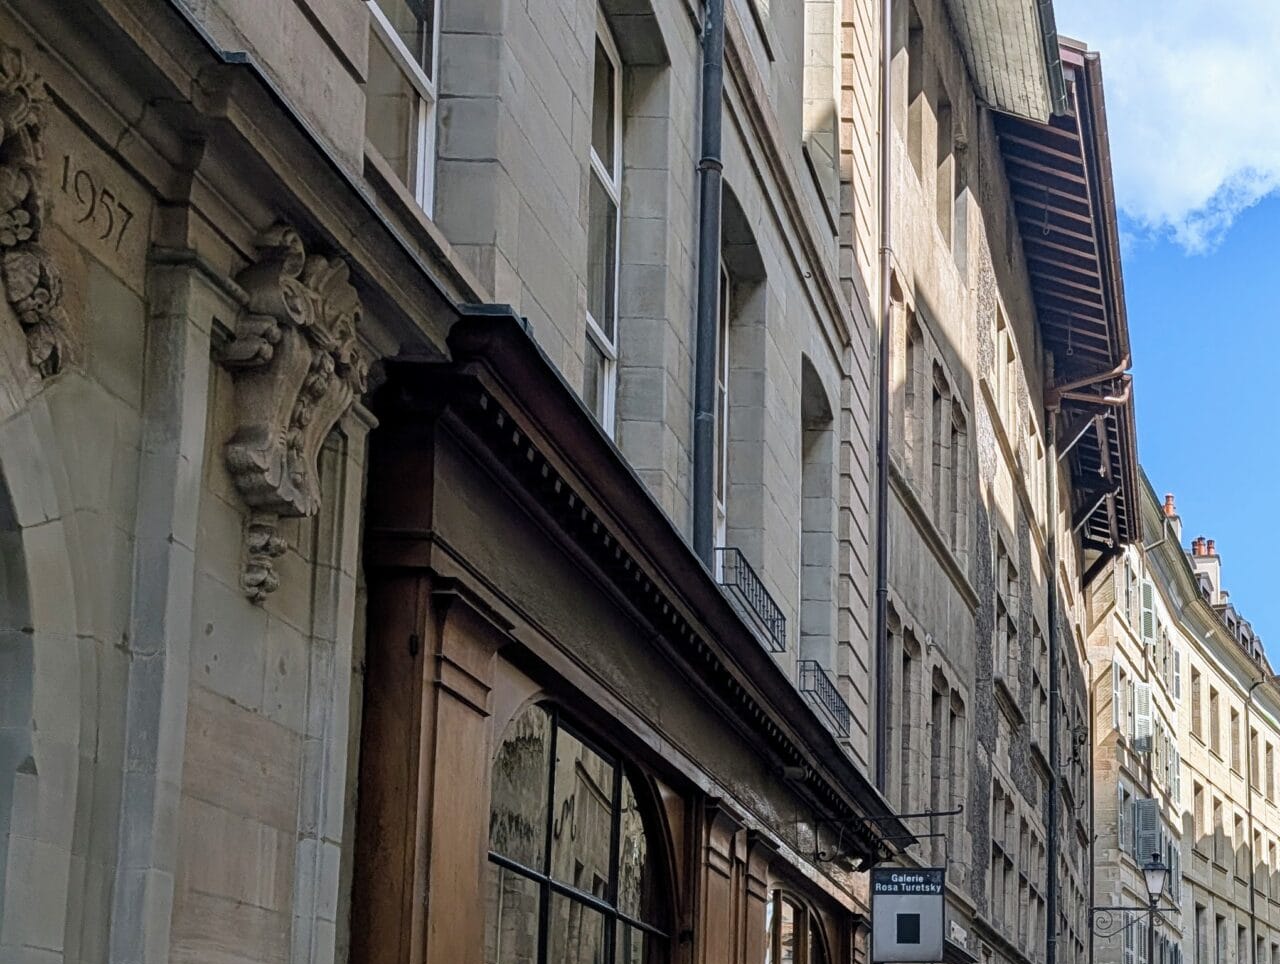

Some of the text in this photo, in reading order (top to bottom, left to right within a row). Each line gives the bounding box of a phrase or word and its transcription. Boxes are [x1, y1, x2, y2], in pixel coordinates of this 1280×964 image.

[61, 155, 134, 252] 1957
[891, 873, 924, 882] Galerie
[875, 883, 941, 893] Rosa Turetsky
